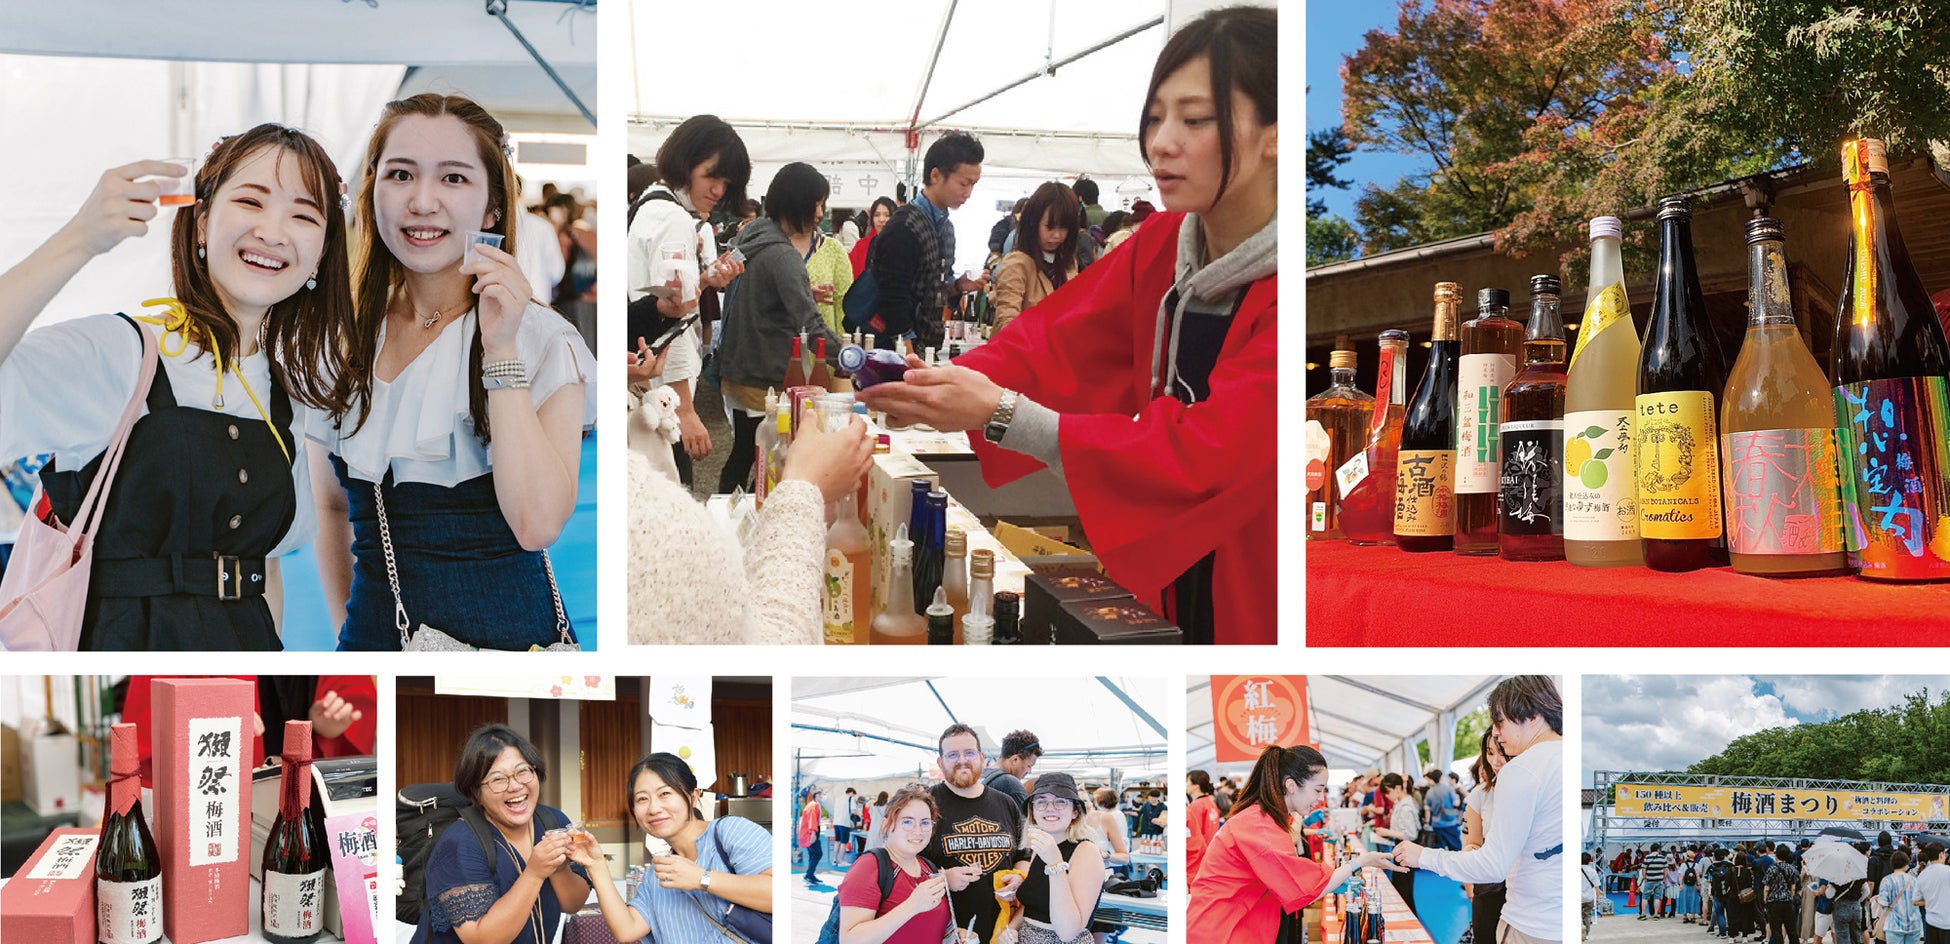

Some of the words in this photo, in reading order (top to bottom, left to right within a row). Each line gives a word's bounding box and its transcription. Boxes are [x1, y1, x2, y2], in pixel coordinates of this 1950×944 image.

[1640, 402, 1679, 416] tete
[1403, 454, 1435, 497] 古酒
[1896, 453, 1924, 494] 梅酒
[1406, 496, 1418, 522] 仕込み
[1616, 505, 1636, 516] お酒
[1243, 680, 1278, 746] 紅梅
[197, 731, 232, 795] 獺祭
[1634, 790, 1652, 800] 150
[1654, 790, 1682, 801] 種以上
[1731, 791, 1838, 816] 梅酒まつり
[1854, 795, 1898, 806] 梅酒と料理の
[1643, 801, 1708, 813] 飲み比べ&販売
[1862, 807, 1918, 816] コラボレーション
[205, 801, 223, 838] 梅酒
[961, 821, 996, 833] MOTOR
[1643, 819, 1660, 828] 受付
[339, 830, 377, 857] 梅酒
[947, 836, 1011, 851] HARLEY-DAVIDSON
[965, 851, 999, 868] CYCLES
[131, 886, 149, 917] 獺祭
[299, 878, 316, 908] 獺祭
[136, 918, 147, 939] 梅酒
[302, 909, 312, 930] 梅酒
